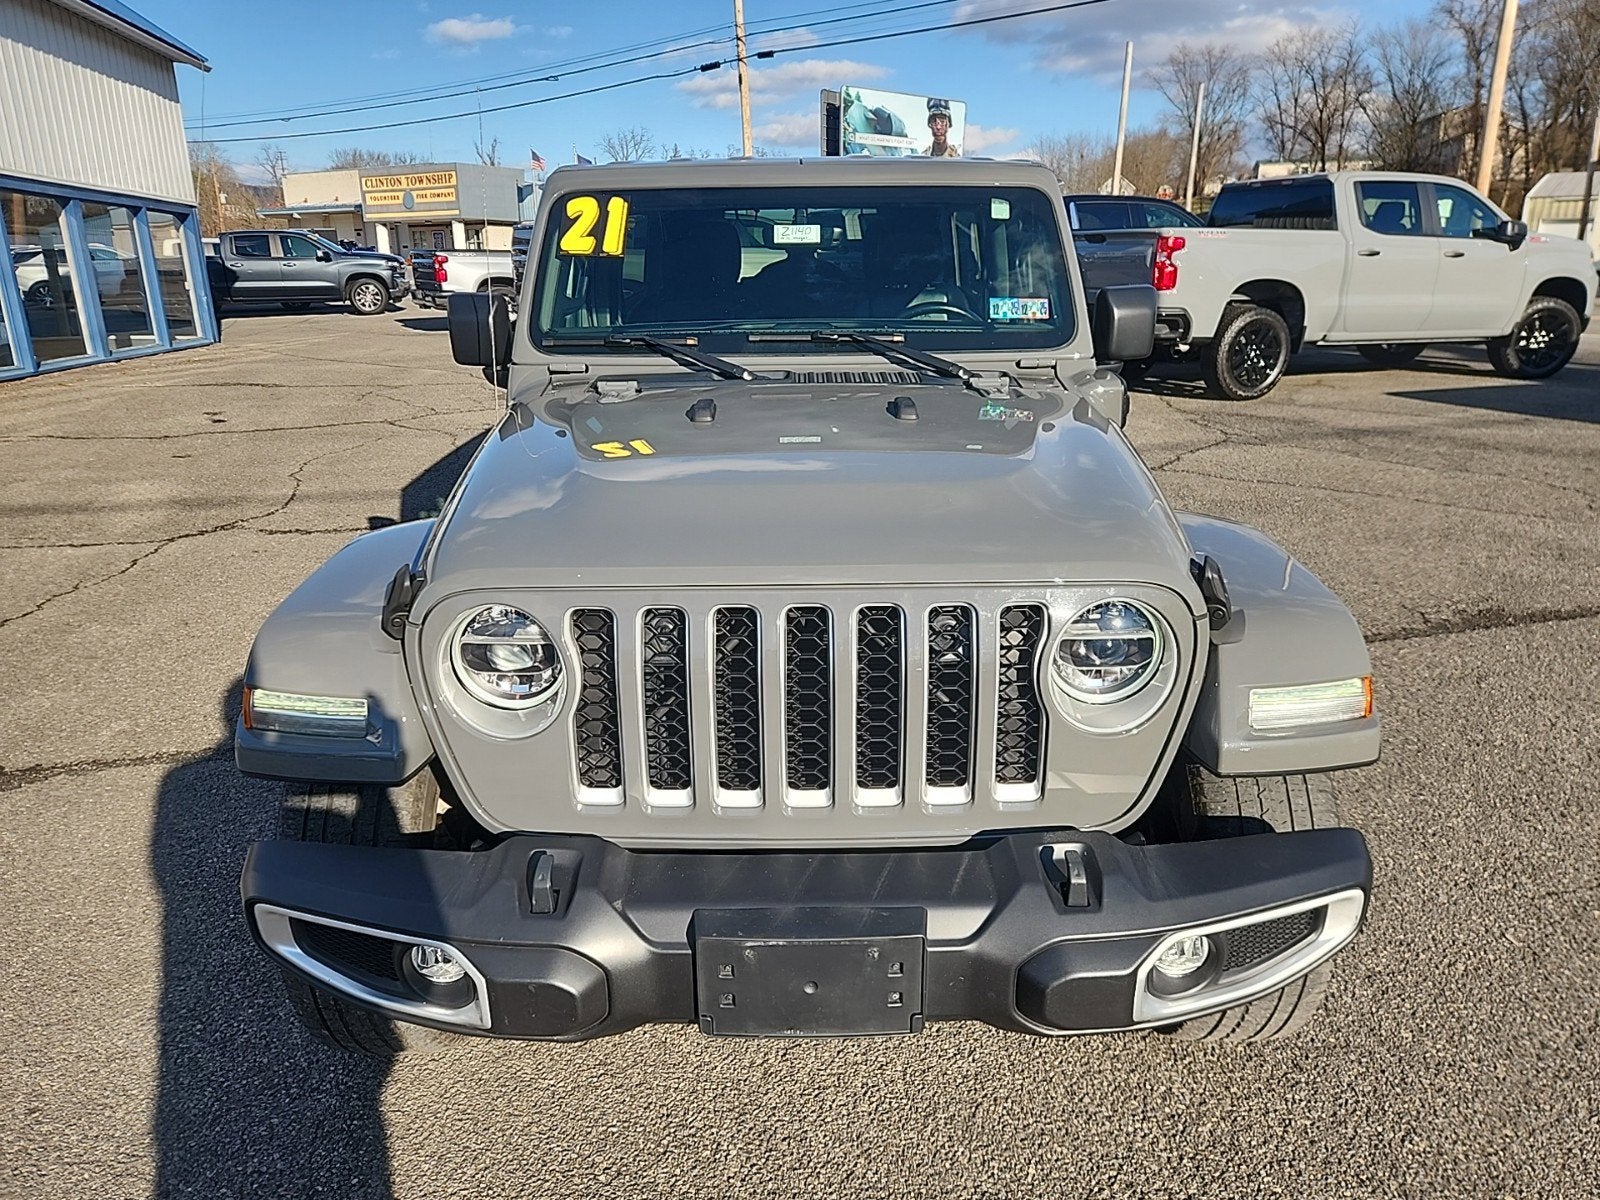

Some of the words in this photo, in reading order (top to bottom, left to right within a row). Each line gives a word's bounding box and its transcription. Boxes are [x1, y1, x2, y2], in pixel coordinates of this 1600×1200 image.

[365, 177, 402, 189] CLINTON
[404, 173, 453, 187] TOWNSHIP
[560, 196, 628, 255] 21
